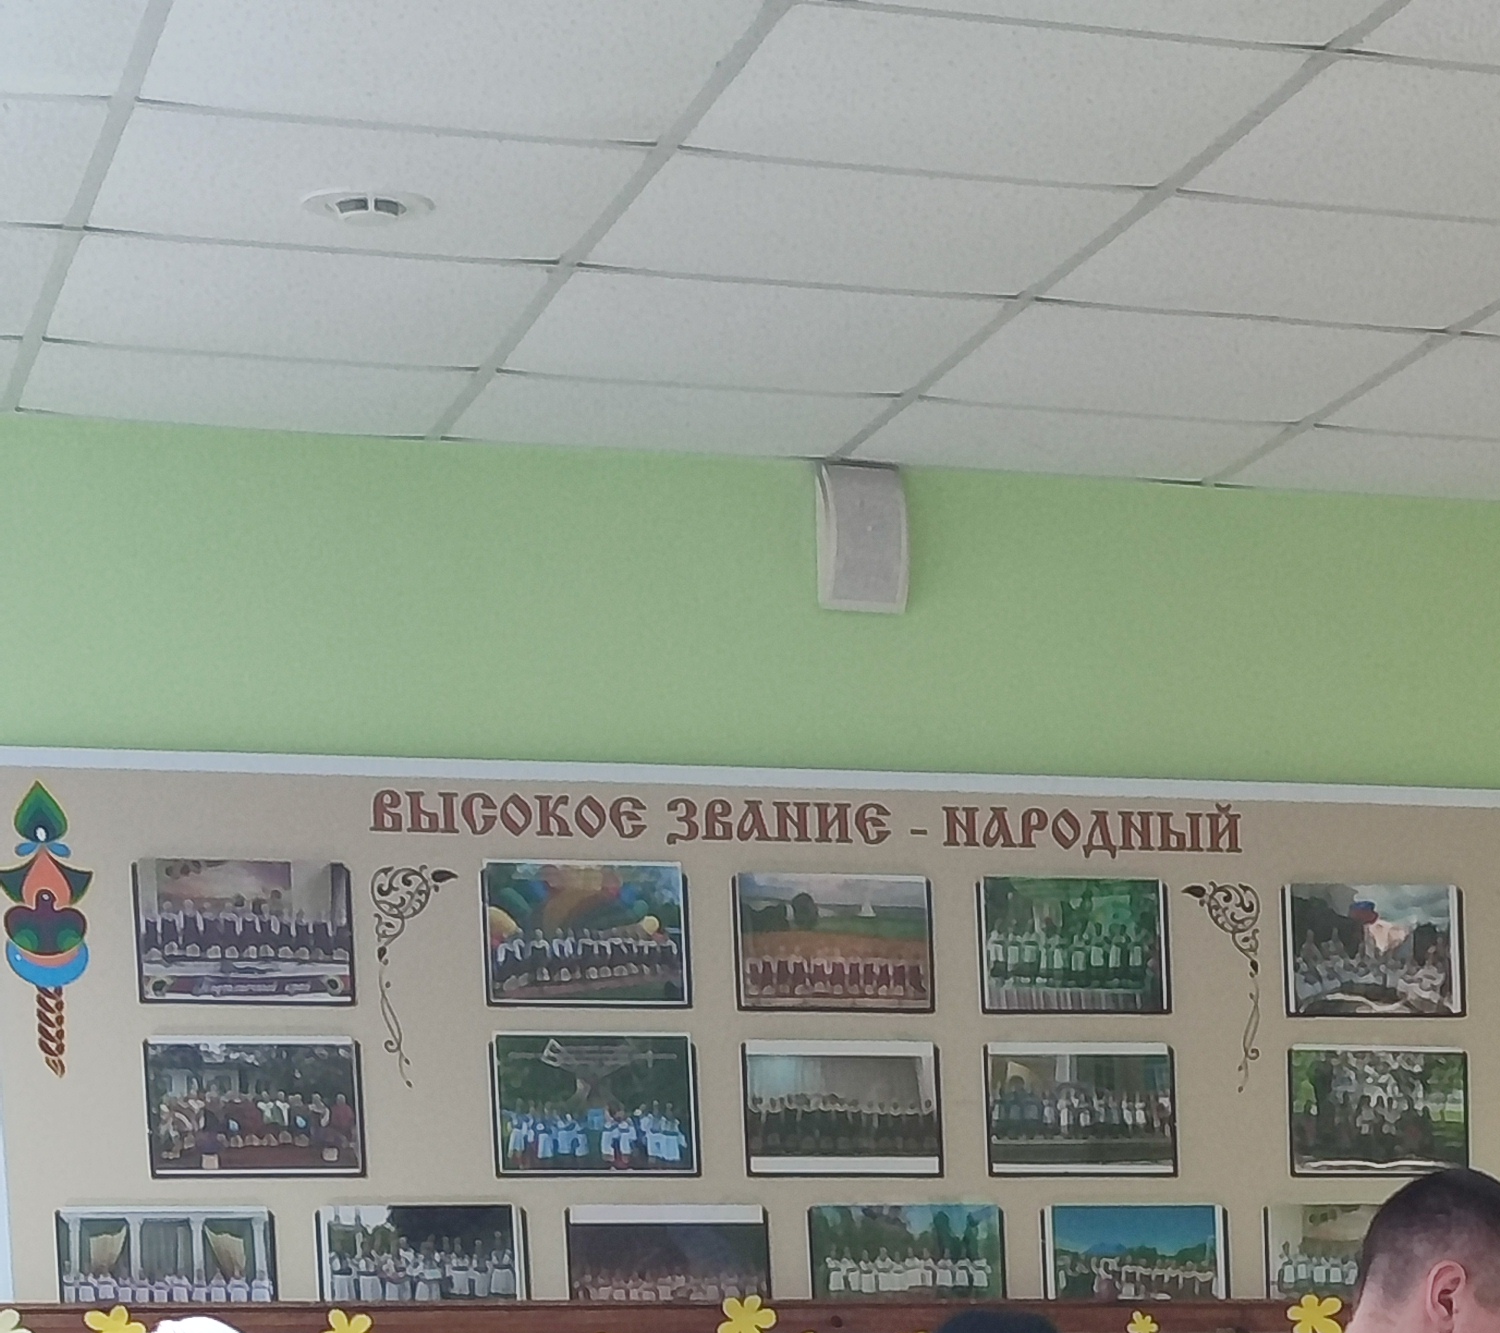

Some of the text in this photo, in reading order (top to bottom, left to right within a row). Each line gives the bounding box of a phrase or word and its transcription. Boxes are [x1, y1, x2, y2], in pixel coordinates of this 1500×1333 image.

[369, 789, 647, 842] ВЫСОКОЕ
[666, 798, 891, 846] ЗВАНИЕ
[941, 803, 1244, 860] НАРОДНЫЙ
